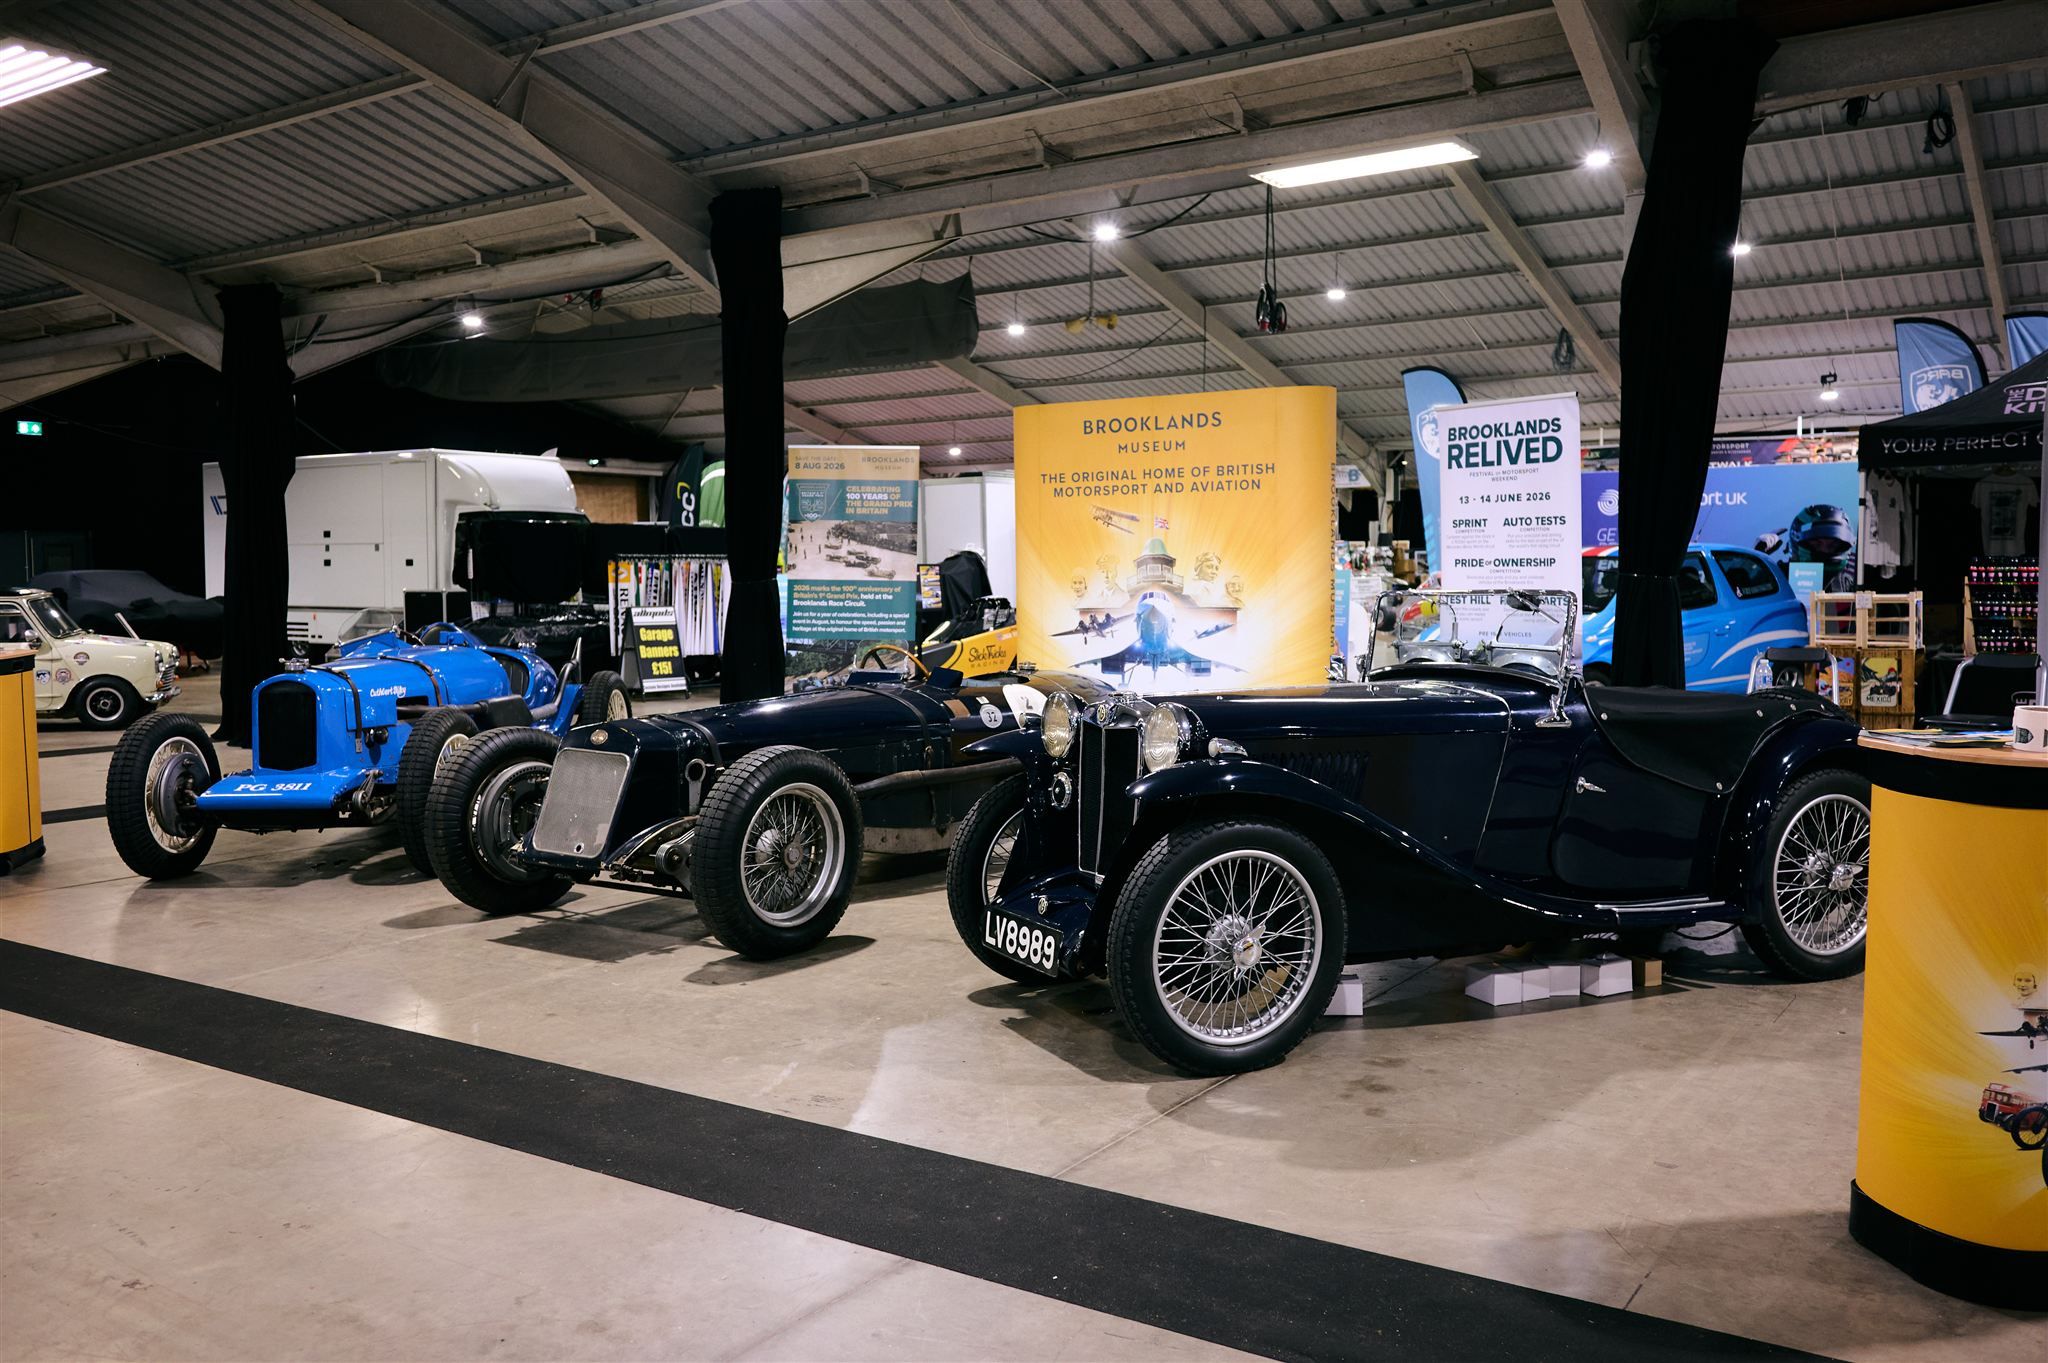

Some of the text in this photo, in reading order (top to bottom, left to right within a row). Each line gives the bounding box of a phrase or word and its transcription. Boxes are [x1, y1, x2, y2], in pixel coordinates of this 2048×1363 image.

[1083, 411, 1222, 435] BROOKLANDS
[1448, 417, 1562, 442] BROOKLANDS
[1118, 440, 1186, 454] MUSEUM
[1881, 437, 1937, 454] YOUR
[1943, 431, 2030, 451] PERFECT
[1448, 435, 1563, 469] RELIVED
[795, 462, 846, 470] 8 AUG 2026
[1041, 463, 1275, 485] THE ORIGINAL HOME OF BRITISH
[846, 485, 900, 493] CELEBRATING
[1053, 479, 1261, 498] MOTORSPORT AND AVIATION
[893, 500, 913, 508] PRIX
[1459, 495, 1470, 504] 13
[1480, 494, 1491, 503] 14
[1495, 493, 1522, 503] JUNE
[1526, 491, 1551, 501] 2026
[1725, 492, 1748, 505] UK
[846, 507, 889, 515] IN BRITAIN
[1452, 518, 1488, 529] SPRINT
[1503, 515, 1566, 527] AUTO TESTS
[1454, 558, 1485, 568] PRIDE
[1493, 557, 1556, 568] OWNERSHIP
[1470, 595, 1491, 605] HILL
[639, 627, 674, 642] Garage
[639, 645, 680, 659] Banners
[986, 711, 998, 722] 32
[233, 782, 313, 792] PG 3811
[985, 910, 1056, 970] LV8989
